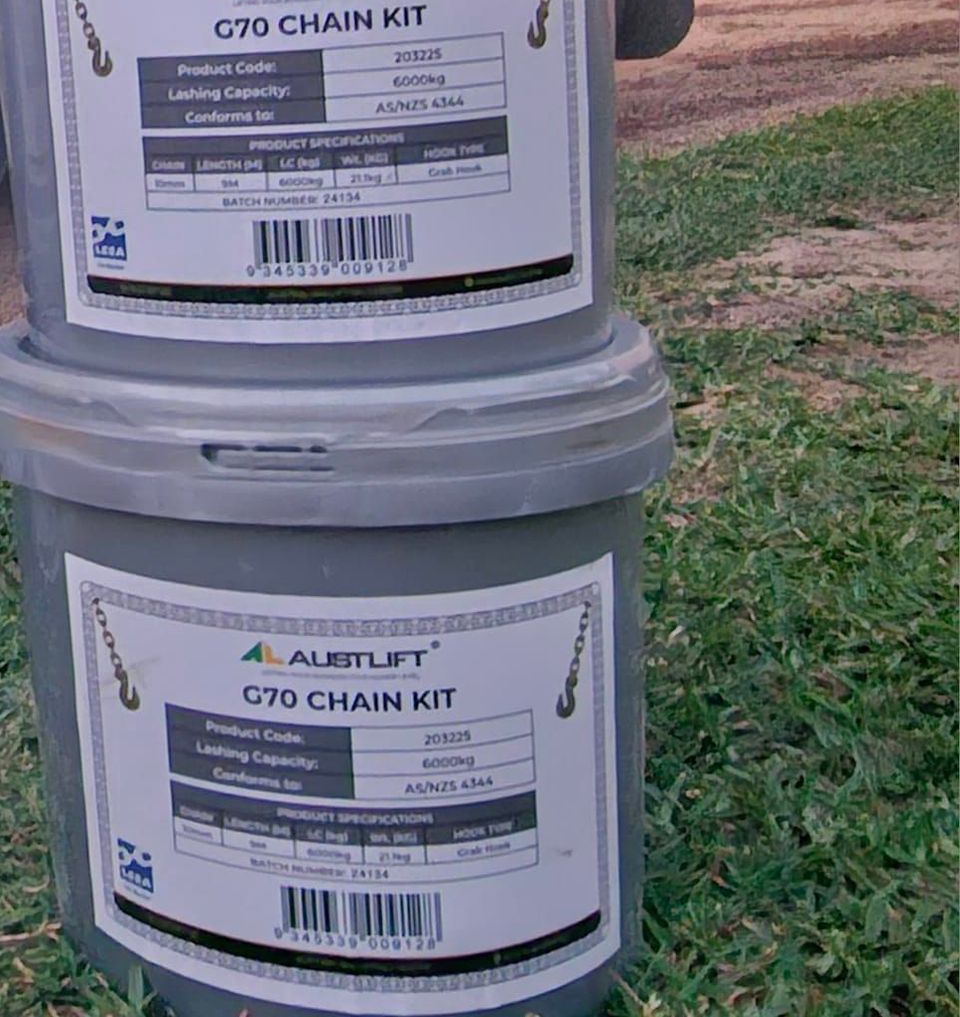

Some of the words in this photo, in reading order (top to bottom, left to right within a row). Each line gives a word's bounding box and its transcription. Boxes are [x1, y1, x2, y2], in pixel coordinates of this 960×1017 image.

[213, 17, 270, 40] G70
[278, 9, 373, 36] CHAIN
[383, 4, 428, 30] KIT
[394, 47, 443, 64] 203225
[177, 62, 232, 77] Product
[235, 60, 277, 76] Code:
[393, 73, 446, 89] 6000kg
[167, 85, 222, 103] Lashing
[224, 83, 291, 101] Capacity:
[185, 110, 253, 124] Conforms
[288, 649, 428, 669] AUSTLIFT
[242, 685, 298, 709] G70
[307, 690, 402, 712] CHAIN
[412, 687, 457, 711] KIT
[205, 719, 261, 739] Product
[424, 730, 472, 745] 203225
[195, 740, 250, 763] Lashing
[252, 750, 319, 771] Capacity:
[422, 755, 476, 770] 6000kg
